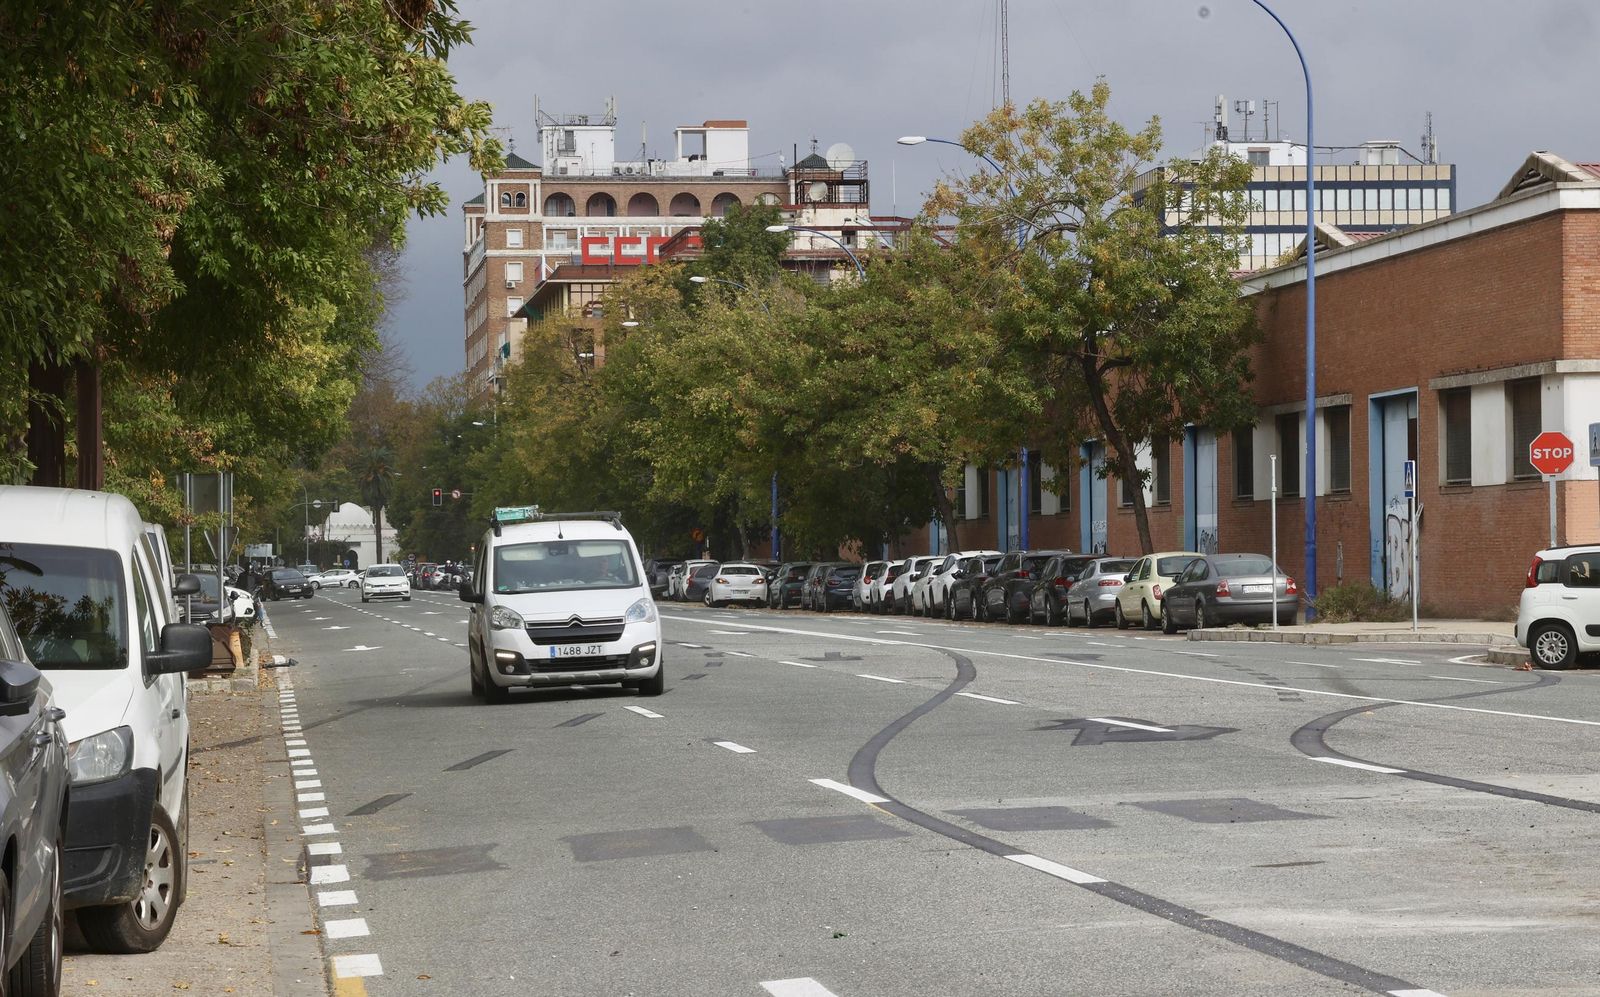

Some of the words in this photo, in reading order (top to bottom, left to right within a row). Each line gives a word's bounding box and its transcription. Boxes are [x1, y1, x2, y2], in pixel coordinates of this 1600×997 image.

[1533, 447, 1572, 459] STOP
[558, 646, 582, 656] 1488
[585, 645, 602, 655] JZT
